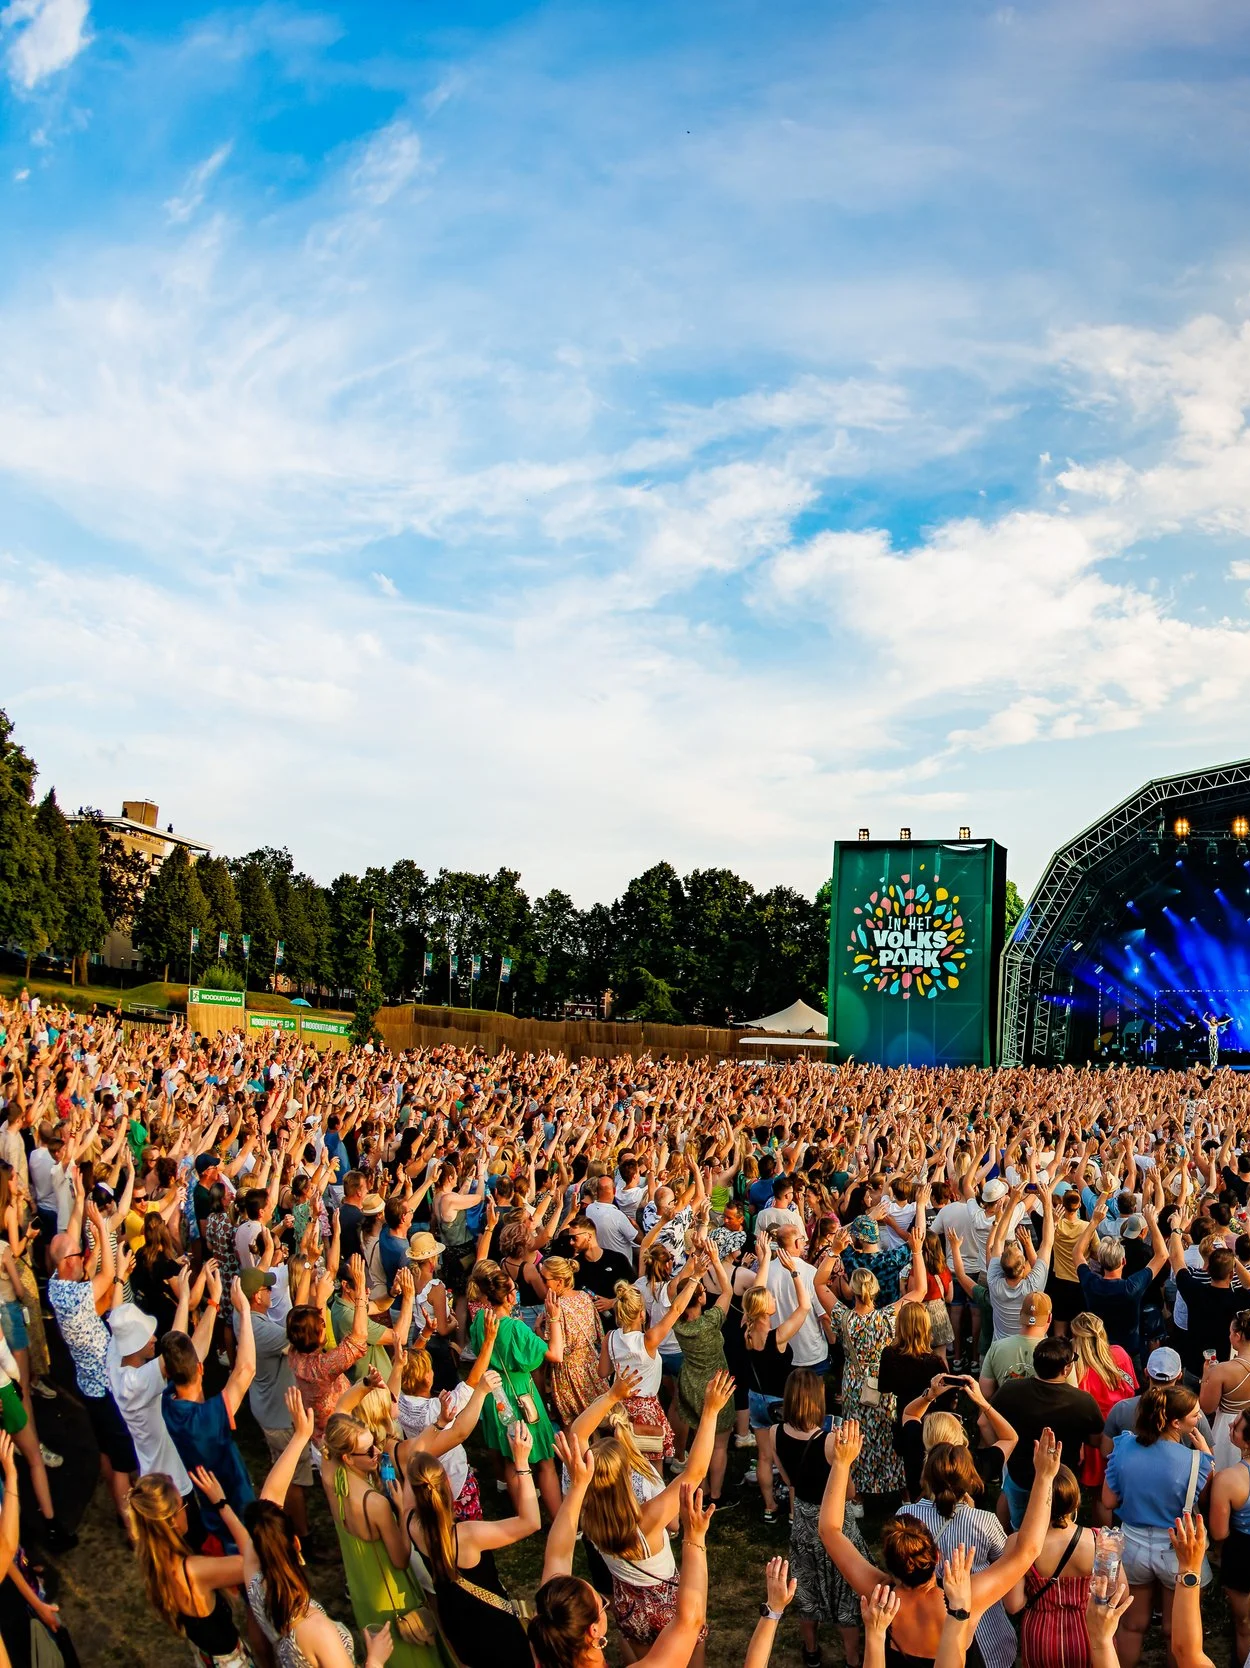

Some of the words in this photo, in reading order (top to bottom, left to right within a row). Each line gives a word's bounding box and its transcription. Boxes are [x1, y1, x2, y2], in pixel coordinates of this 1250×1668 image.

[888, 916, 901, 931] IN
[908, 916, 932, 930] HET
[873, 929, 948, 949] VOLKS
[879, 948, 941, 968] PARK
[201, 993, 241, 1003] NOODUITGANG
